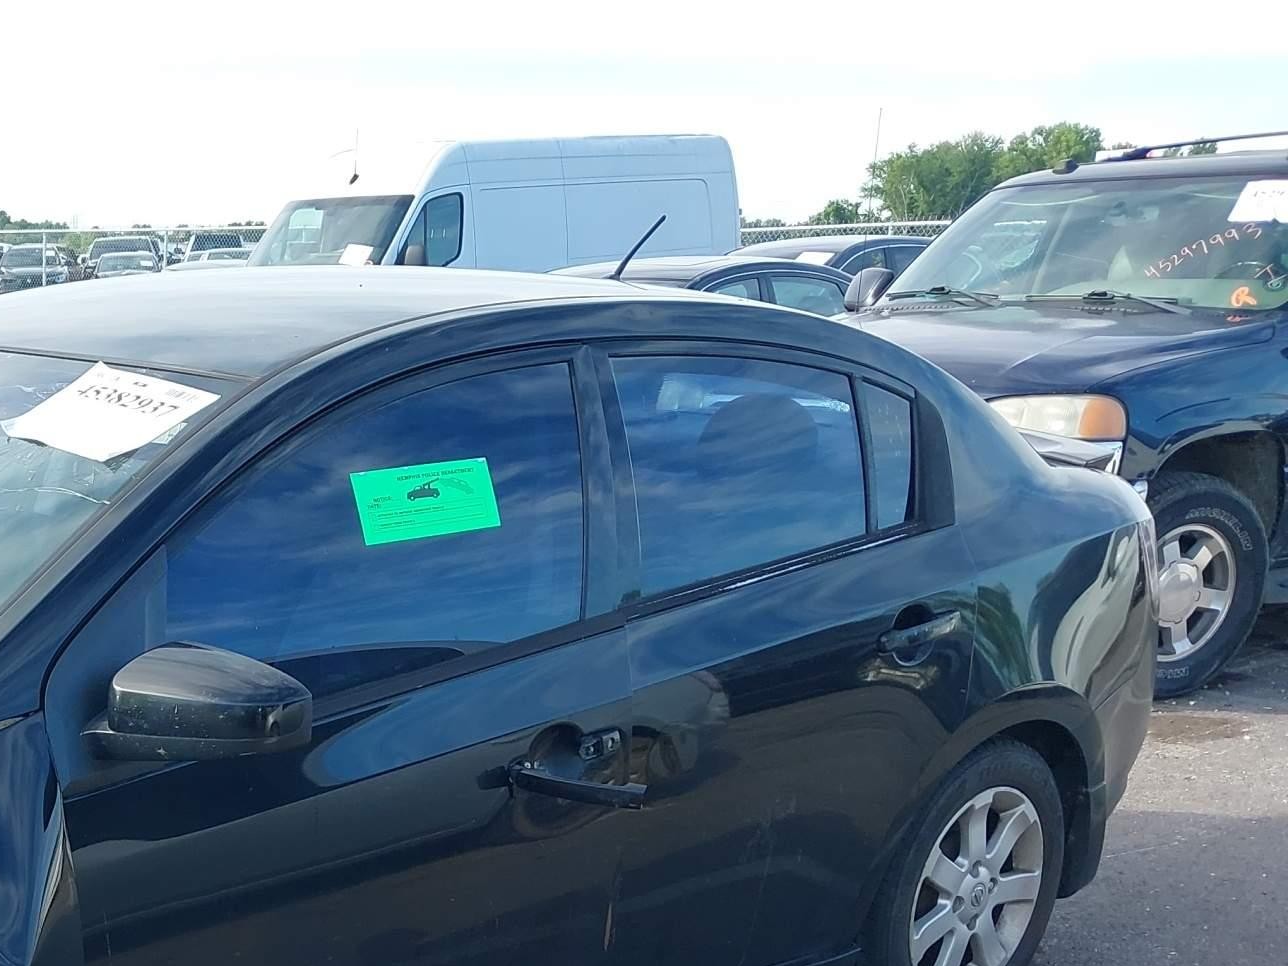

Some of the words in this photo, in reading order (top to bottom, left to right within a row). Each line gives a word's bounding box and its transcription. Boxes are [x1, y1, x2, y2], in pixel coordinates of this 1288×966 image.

[1144, 222, 1261, 278] 45297993
[77, 384, 180, 417] 45382937
[397, 473, 421, 482] MEMPHIS
[421, 470, 441, 479] POLICE
[441, 467, 474, 476] DEPARTMENT
